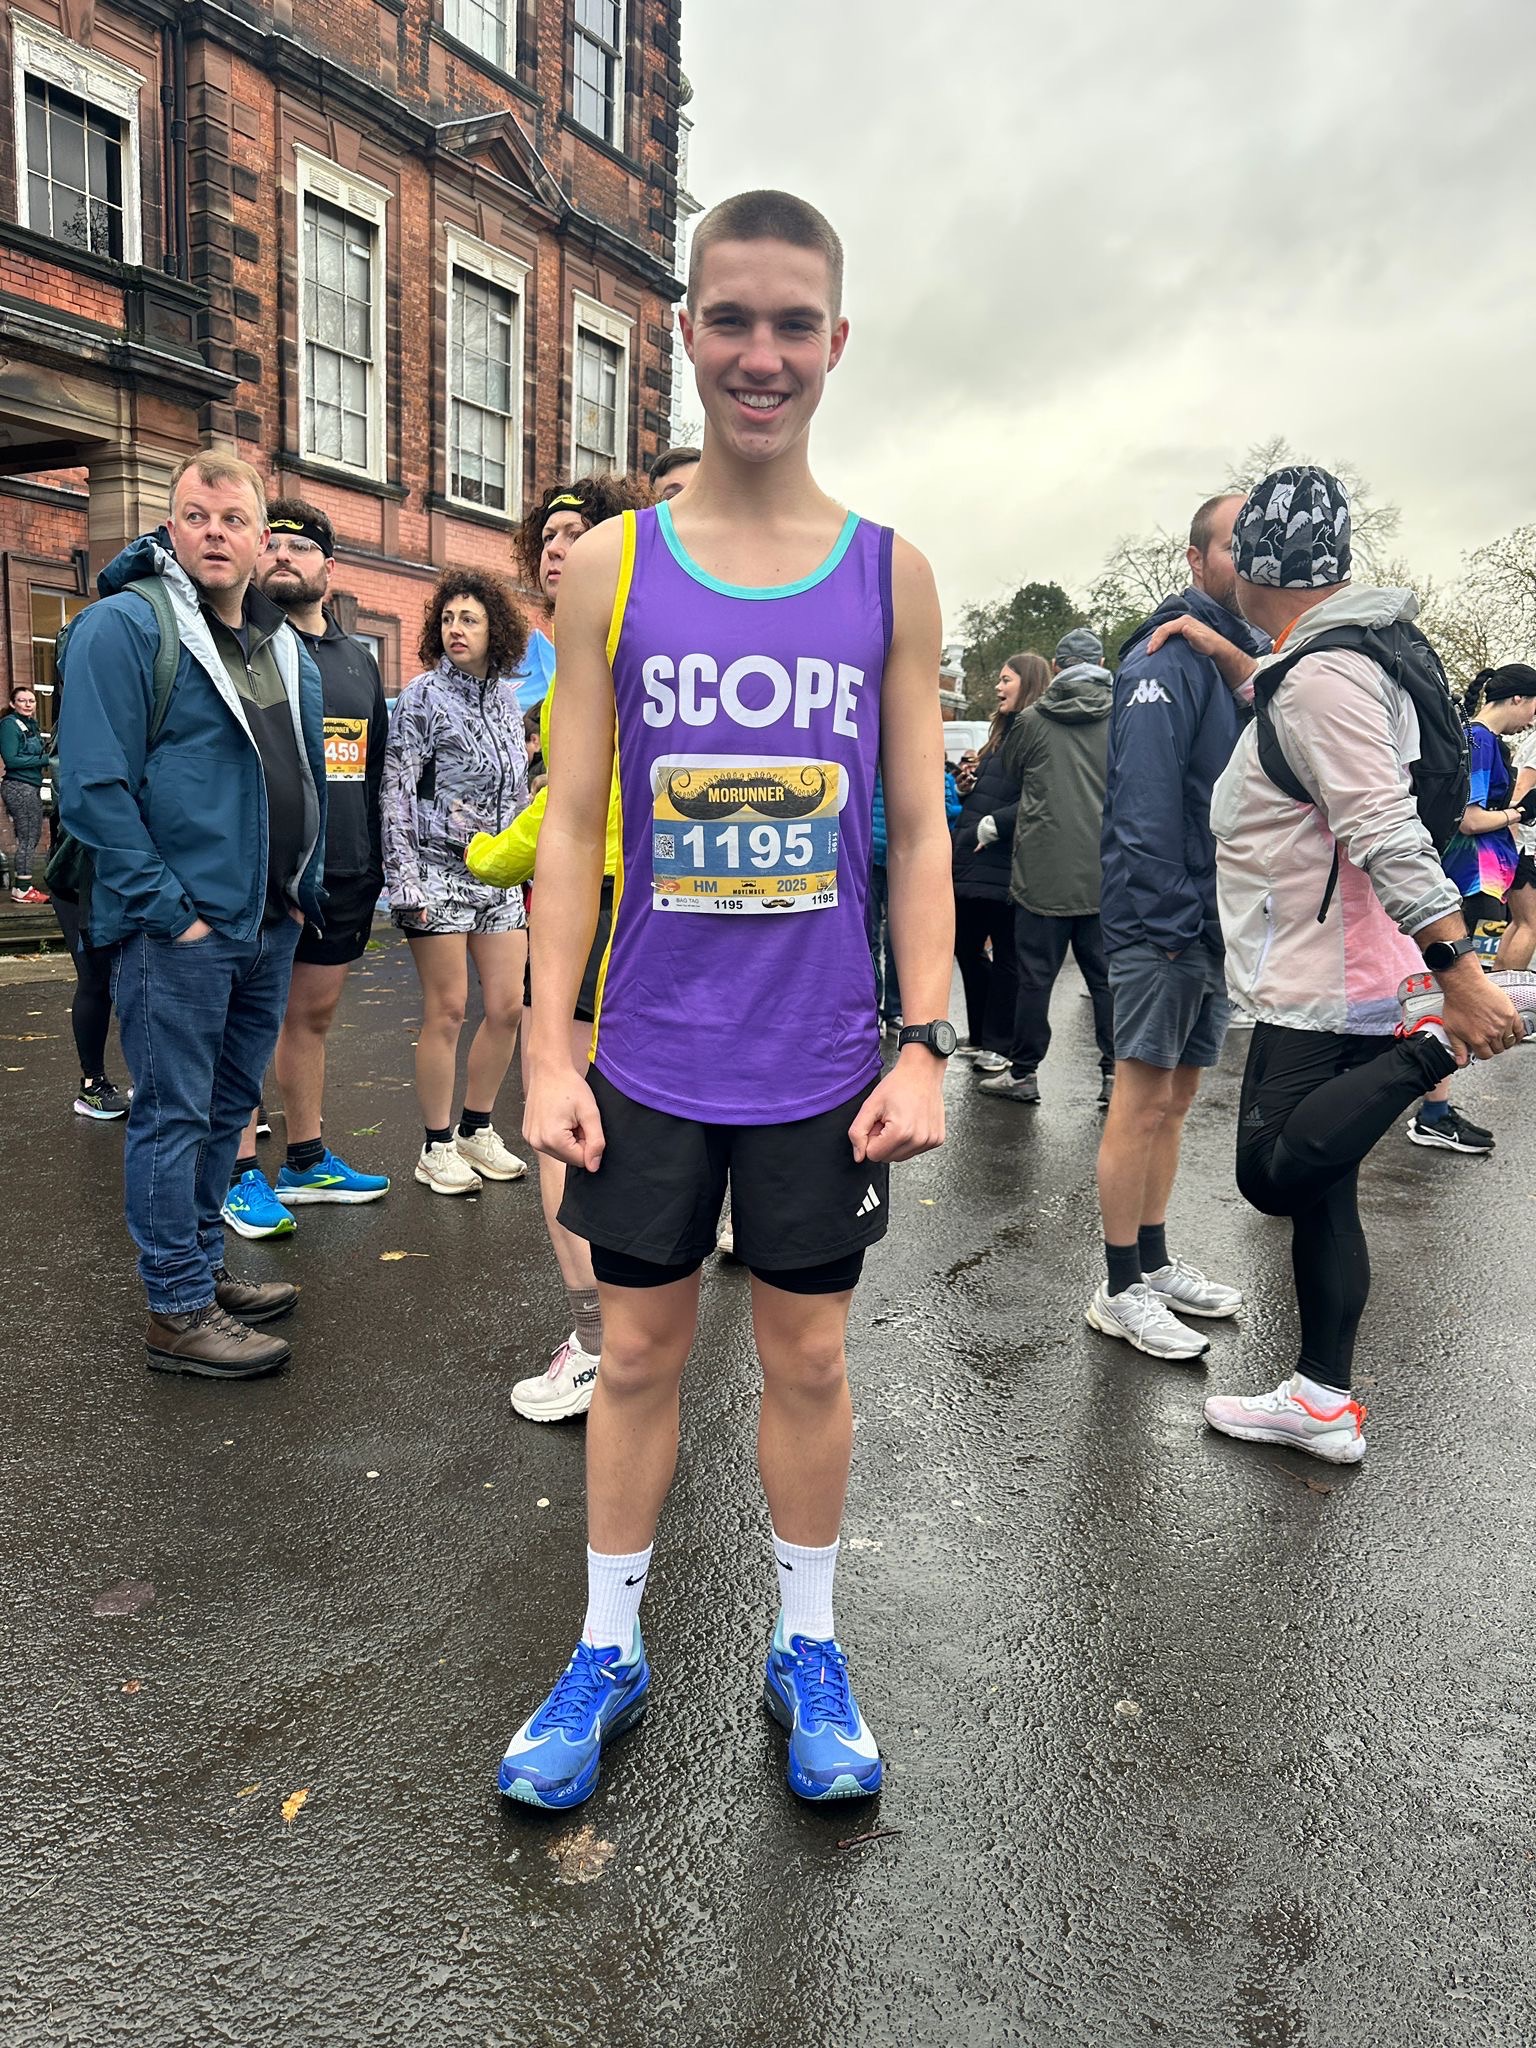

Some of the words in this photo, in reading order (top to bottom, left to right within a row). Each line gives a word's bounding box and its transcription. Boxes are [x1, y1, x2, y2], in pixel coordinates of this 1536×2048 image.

[642, 653, 865, 739] SCOPE
[325, 742, 359, 761] 459
[708, 786, 785, 803] MORUNNER
[682, 823, 814, 869] 1195
[694, 880, 718, 893] HM
[777, 878, 807, 893] 2025
[714, 900, 743, 910] 1195
[811, 893, 834, 905] 1195
